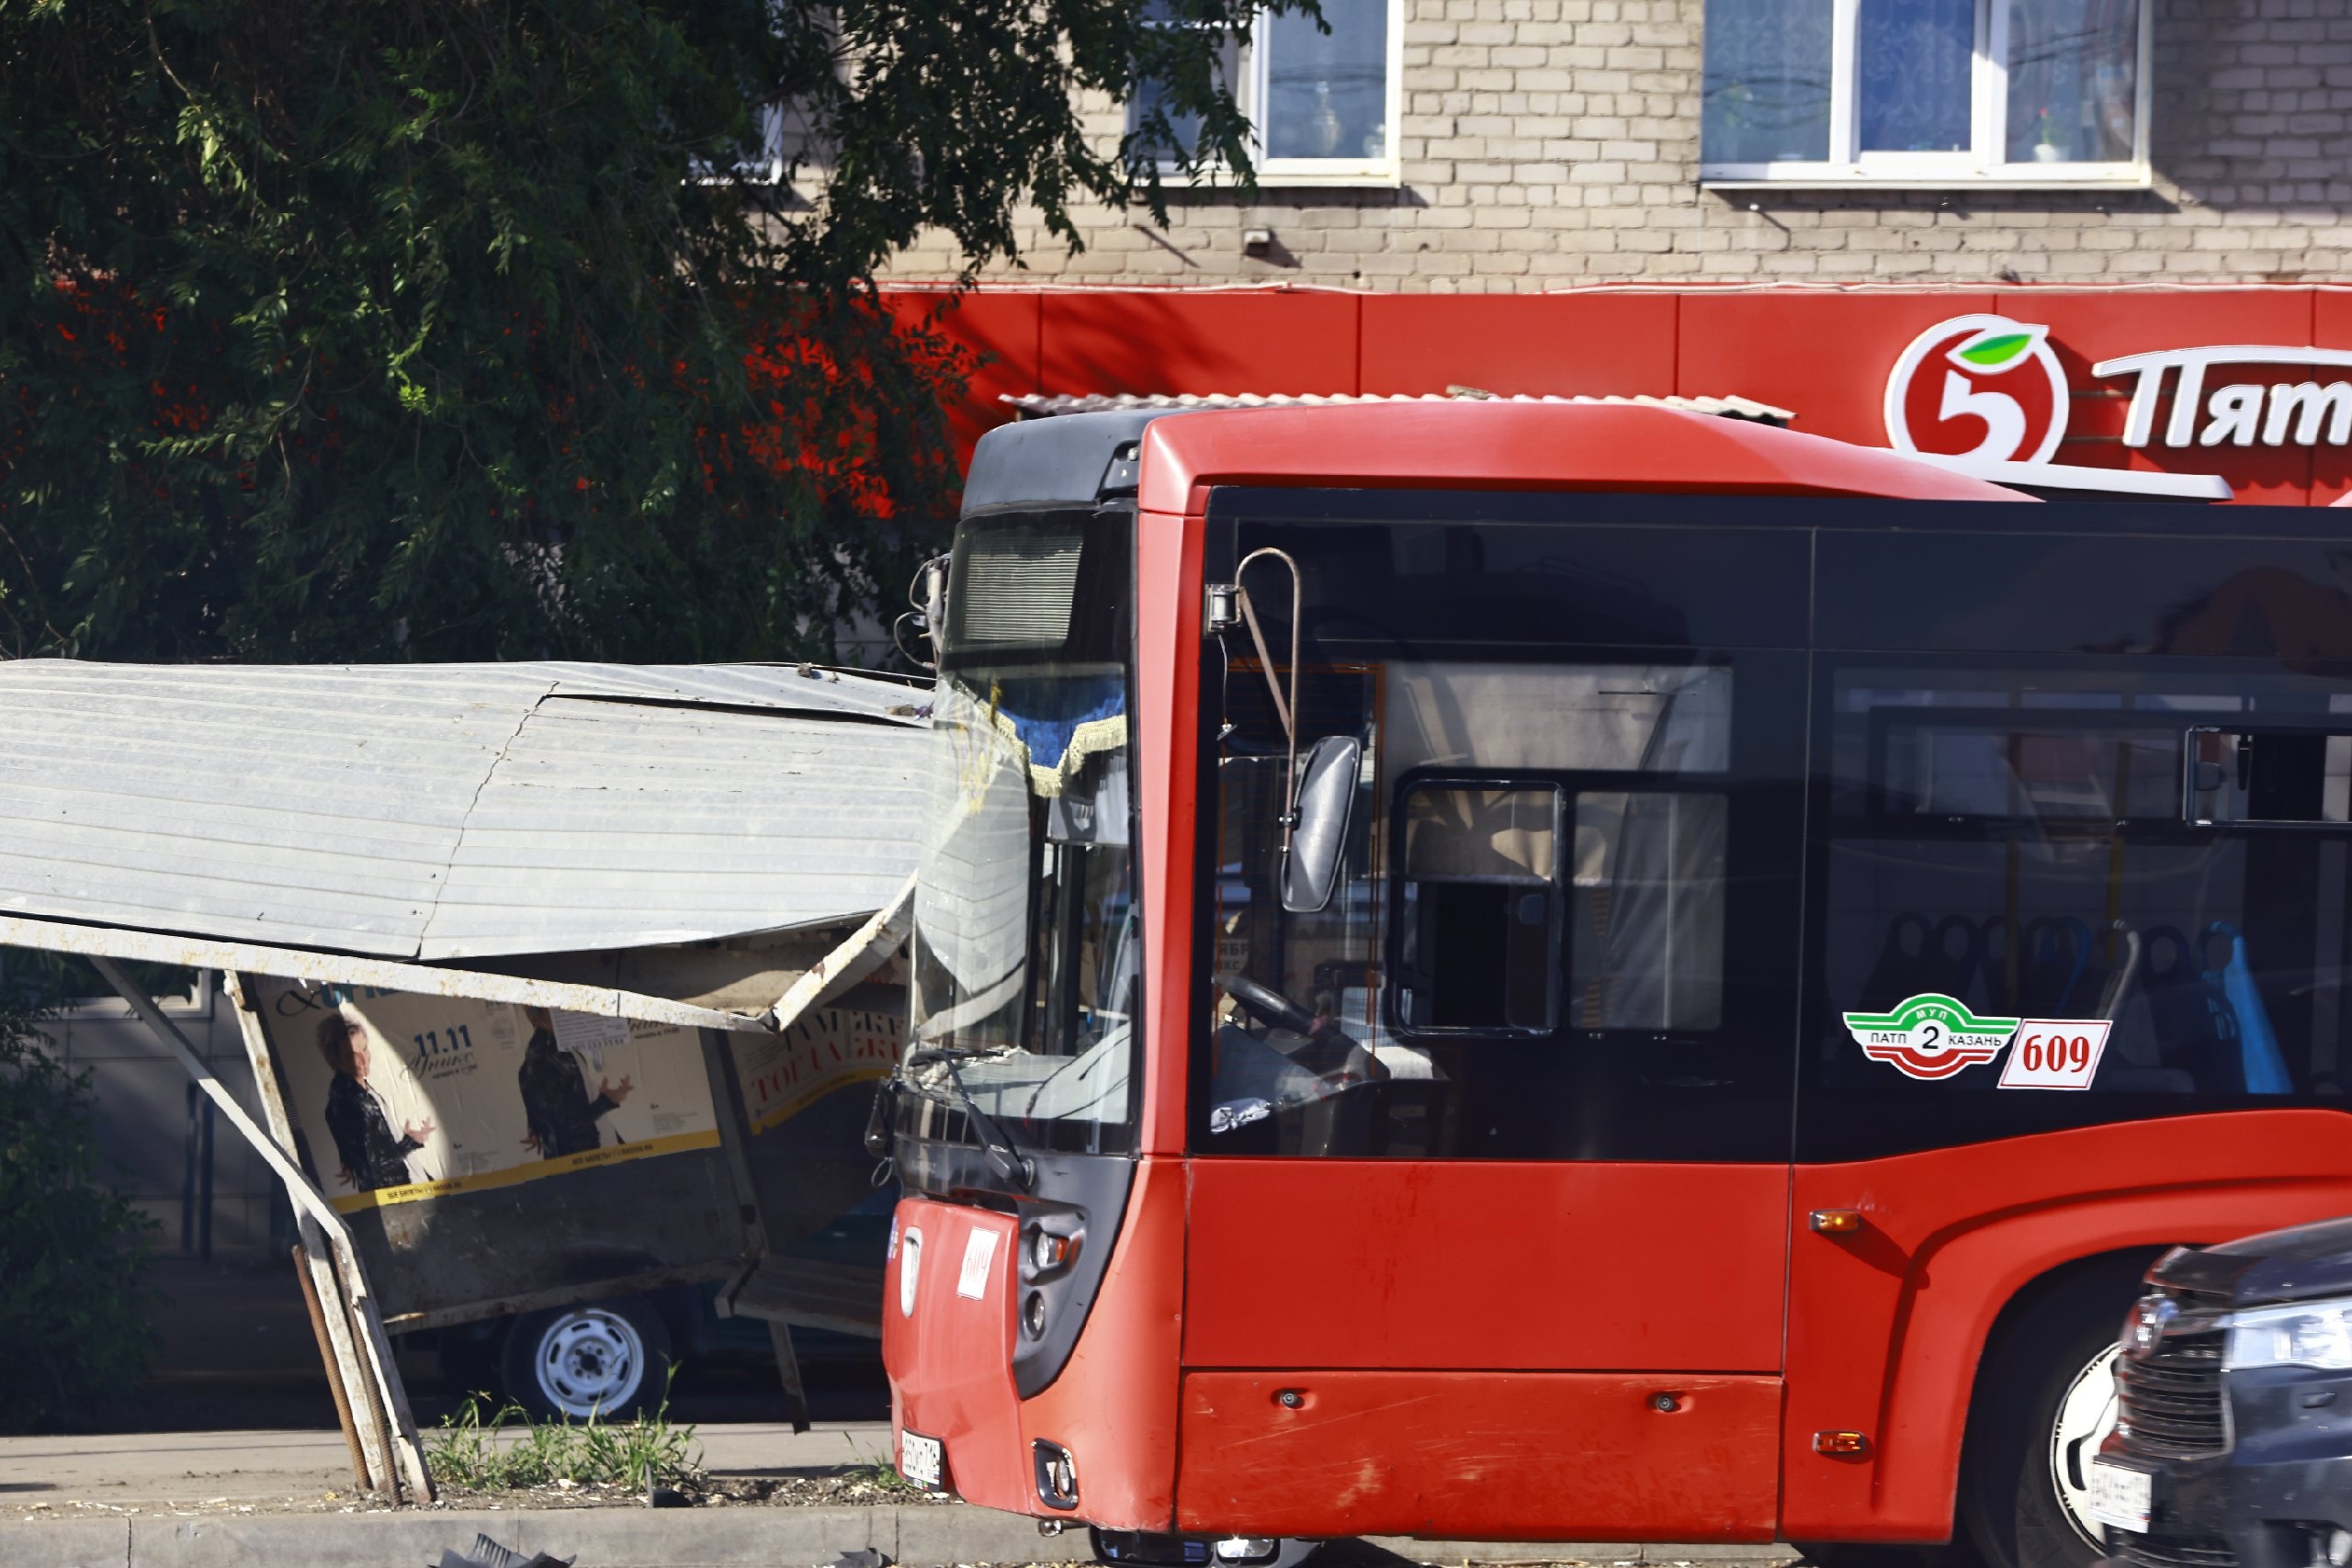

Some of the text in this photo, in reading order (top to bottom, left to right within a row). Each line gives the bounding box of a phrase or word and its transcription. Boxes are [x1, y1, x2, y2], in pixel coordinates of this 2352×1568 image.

[1939, 345, 2352, 461] 5 Пят
[1916, 1008, 1949, 1021] МУП
[414, 1024, 471, 1057] 11.11
[1871, 1025, 2002, 1050] ПАТП 2 КАЗАНЬ
[2023, 1034, 2090, 1073] 609
